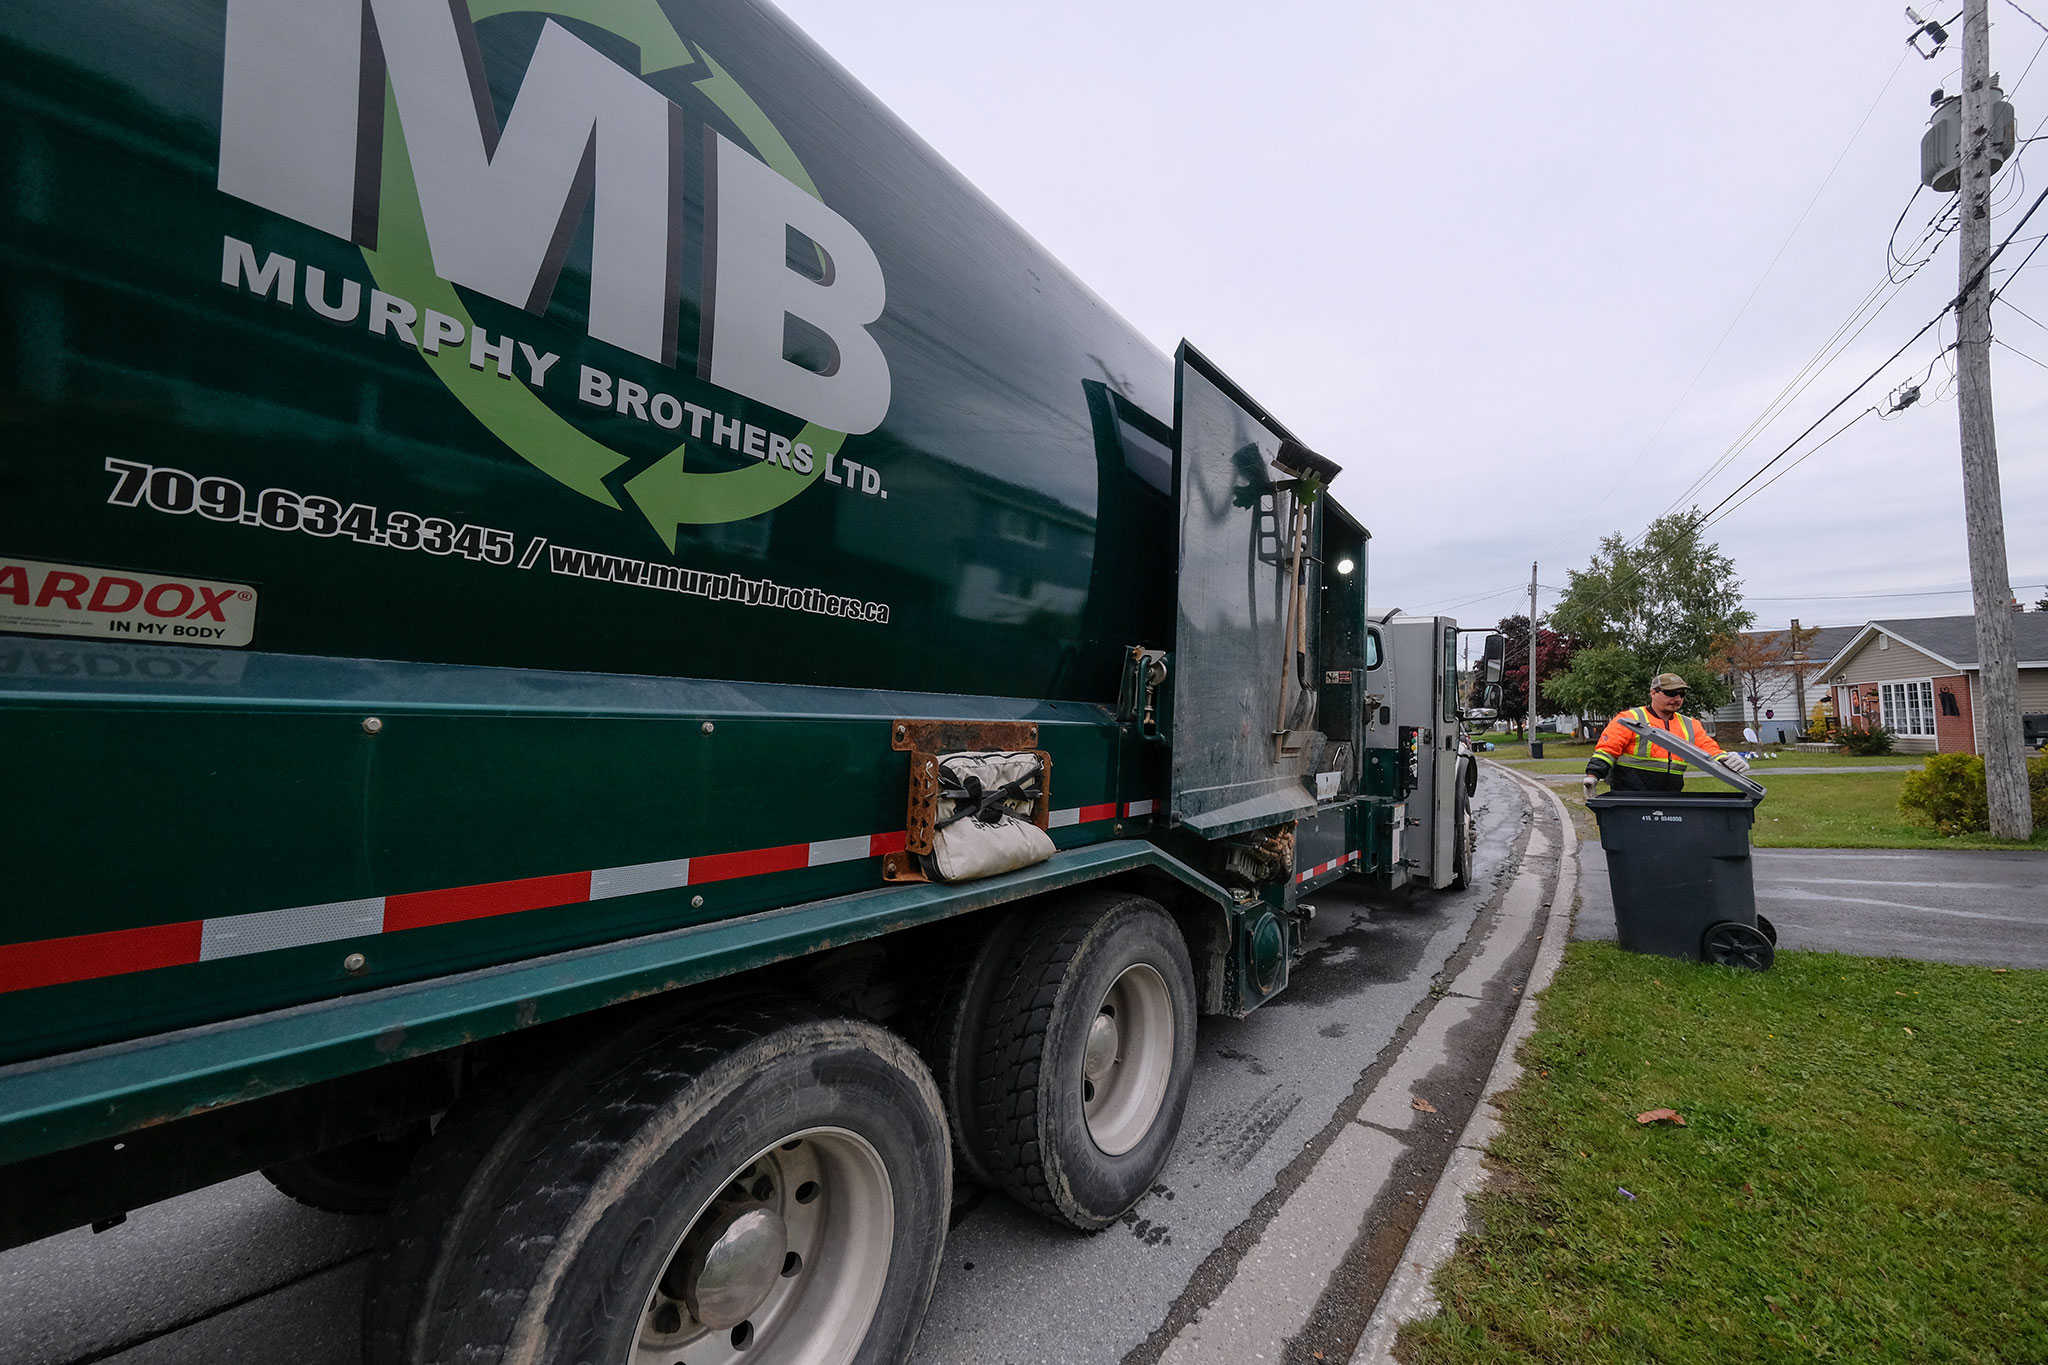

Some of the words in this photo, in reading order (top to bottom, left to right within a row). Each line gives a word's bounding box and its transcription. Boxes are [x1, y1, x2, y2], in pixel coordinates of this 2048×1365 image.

[217, 0, 892, 436] MB
[221, 235, 560, 388] MURPHY
[579, 364, 813, 475] BROTHERS
[824, 453, 888, 499] LTD.
[105, 457, 513, 566] 709.634.3345
[550, 545, 890, 624] www.murphybrothers.ca
[110, 620, 130, 632] IN
[137, 623, 167, 635] MY
[173, 626, 226, 639] BODY
